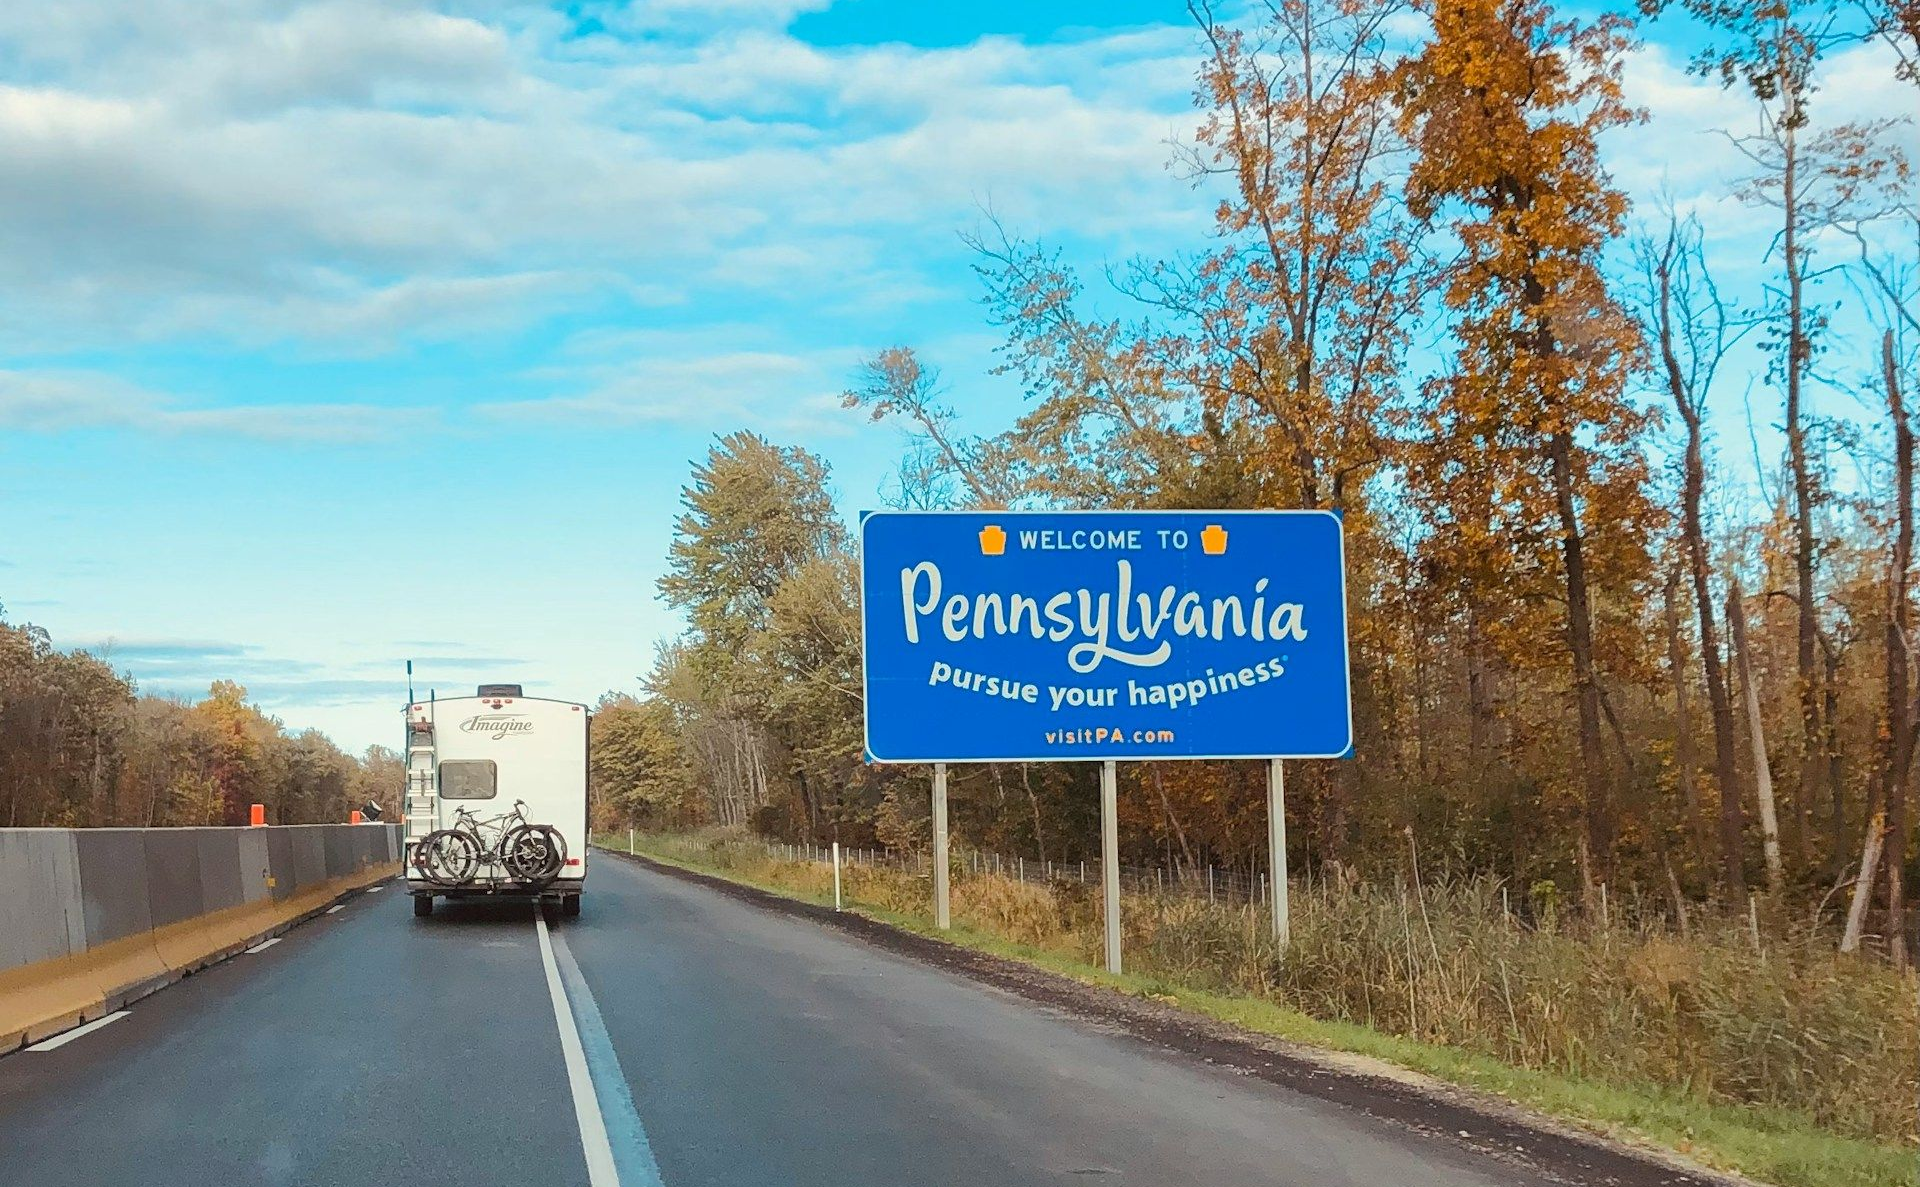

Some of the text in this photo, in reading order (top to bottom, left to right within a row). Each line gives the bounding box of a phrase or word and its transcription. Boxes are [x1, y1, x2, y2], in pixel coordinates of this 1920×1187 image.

[1019, 530, 1189, 550] WELCOME TO
[900, 559, 1309, 674] Pennsylvania
[928, 657, 1285, 712] pursue your happiness
[467, 715, 534, 741] Imagine
[1045, 728, 1175, 744] visitPA.com
